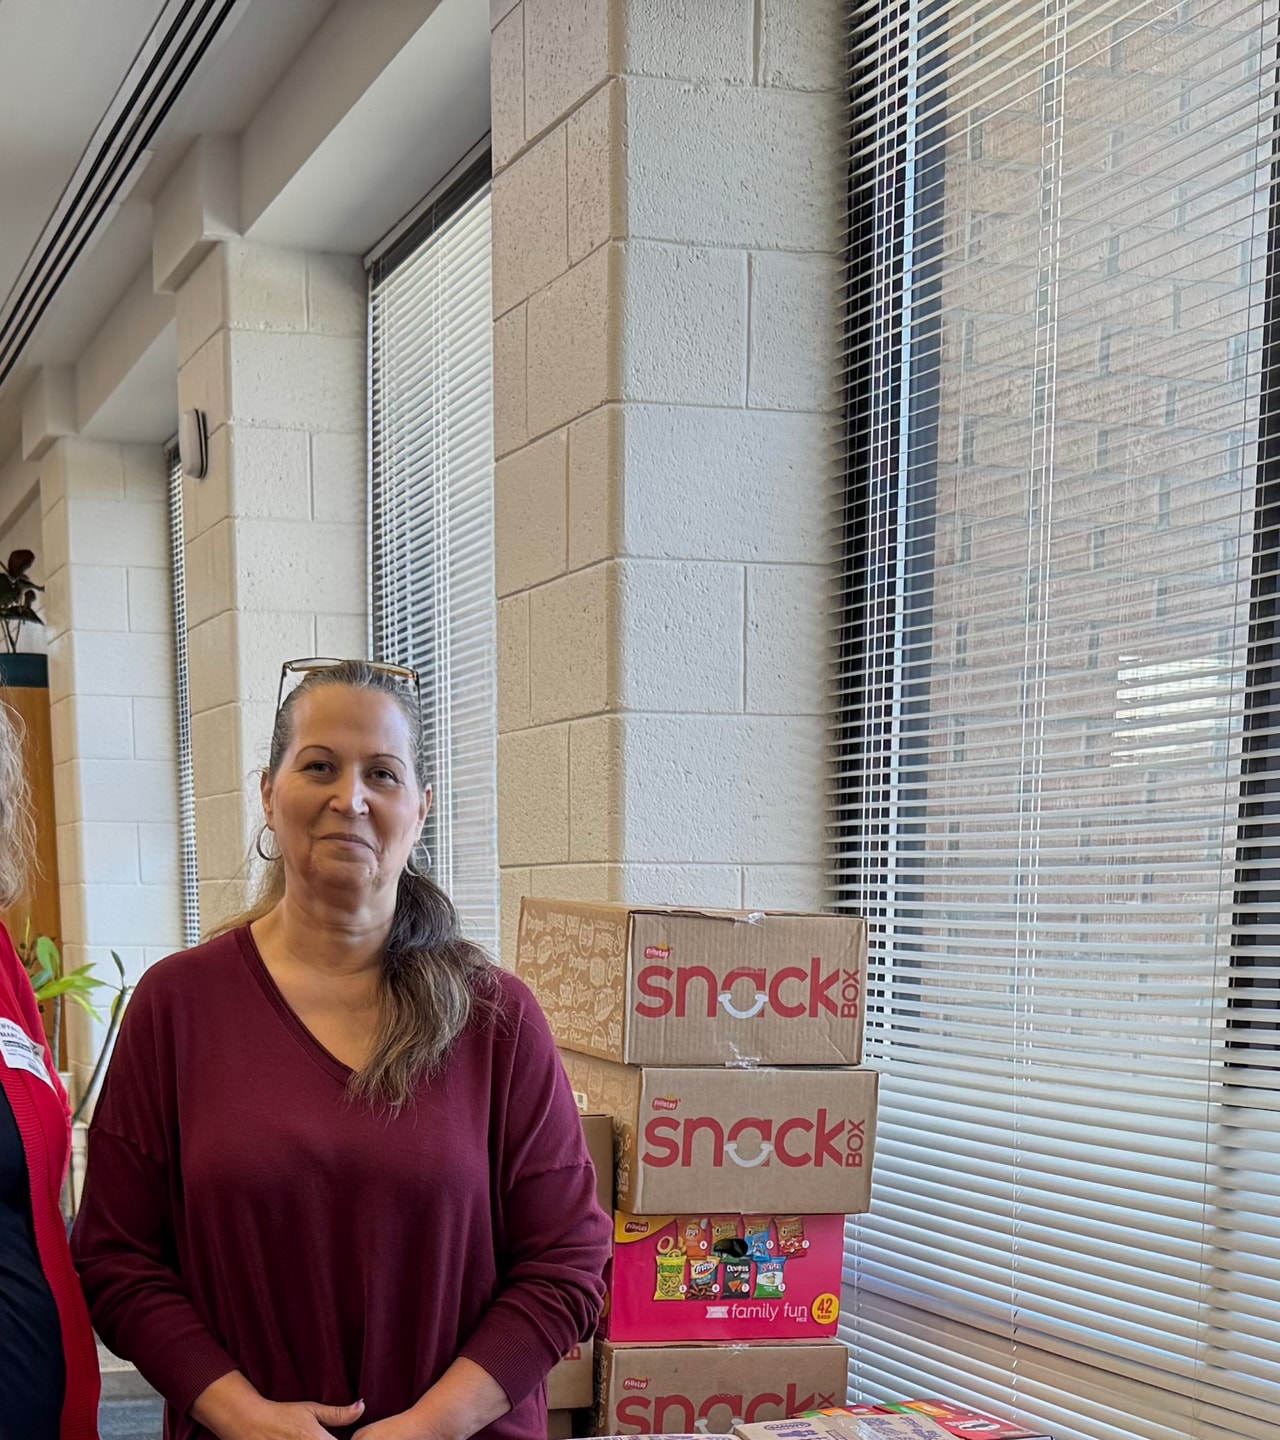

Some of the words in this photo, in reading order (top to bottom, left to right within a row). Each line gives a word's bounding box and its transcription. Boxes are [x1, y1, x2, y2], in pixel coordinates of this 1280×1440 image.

[635, 957, 840, 1019] snack
[841, 968, 860, 1019] BOX
[642, 1108, 846, 1168] snack
[845, 1119, 865, 1168] BOX
[731, 1303, 779, 1322] family
[783, 1302, 808, 1318] fun
[816, 1298, 833, 1314] 42
